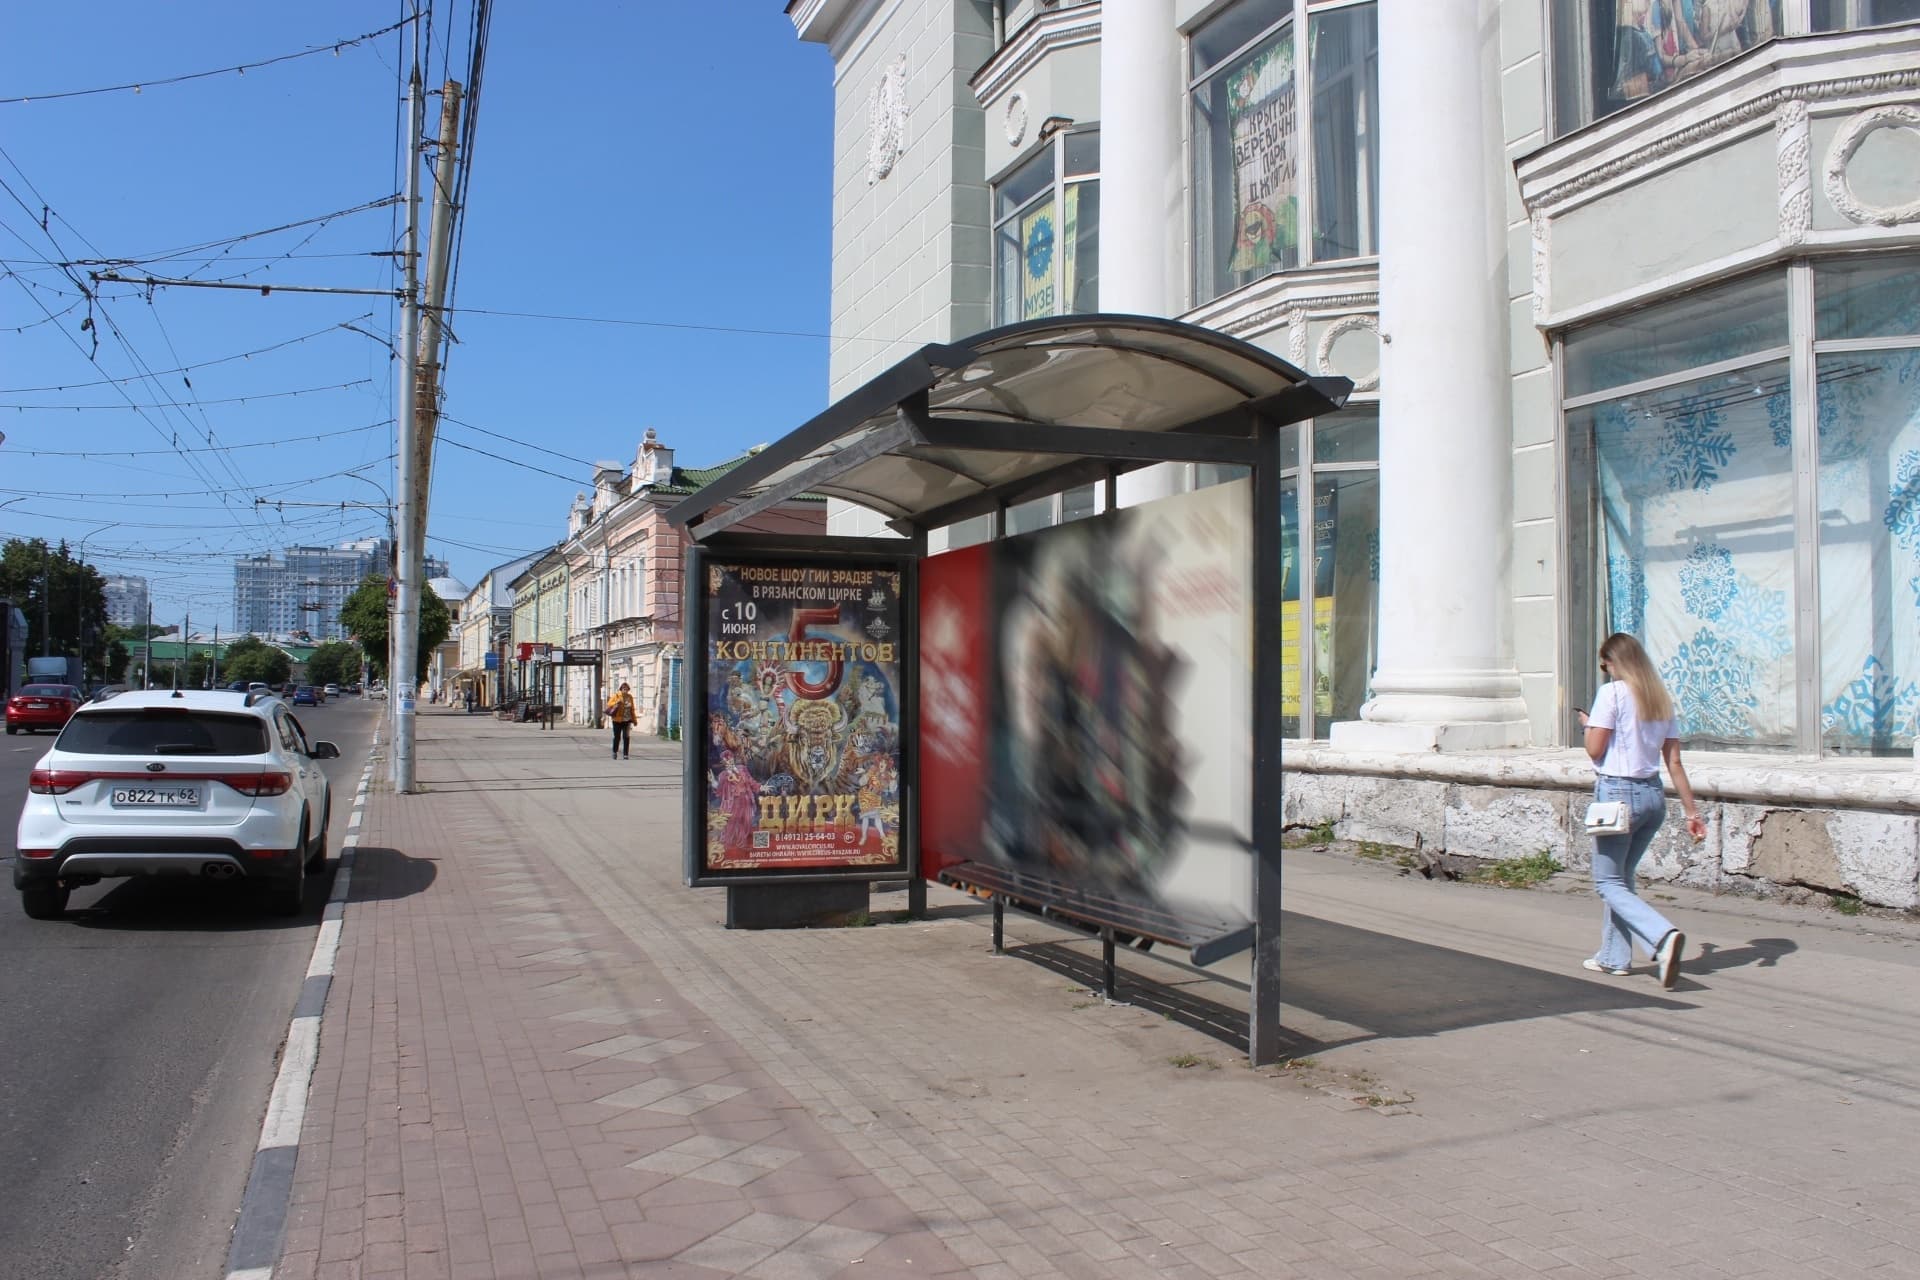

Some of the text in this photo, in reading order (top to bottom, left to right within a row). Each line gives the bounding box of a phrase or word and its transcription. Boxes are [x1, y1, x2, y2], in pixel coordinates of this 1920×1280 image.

[1236, 111, 1296, 166] ВЕРЕВОЧН
[1263, 141, 1287, 175] ПАРК
[740, 567, 873, 586] НОВОЕ ШОУ ГИИ ЭРАДЗЕ
[752, 586, 862, 602] В РЯЗАНСКОМ ЦИРКЕ
[734, 601, 757, 621] 10
[721, 623, 756, 634] ИЮНЯ
[716, 640, 895, 663] КОНТИНЕНТОВ
[785, 602, 844, 700] 5
[179, 788, 195, 800] 62
[758, 794, 856, 832] ЦИРК
[804, 832, 836, 841] 25-64-03
